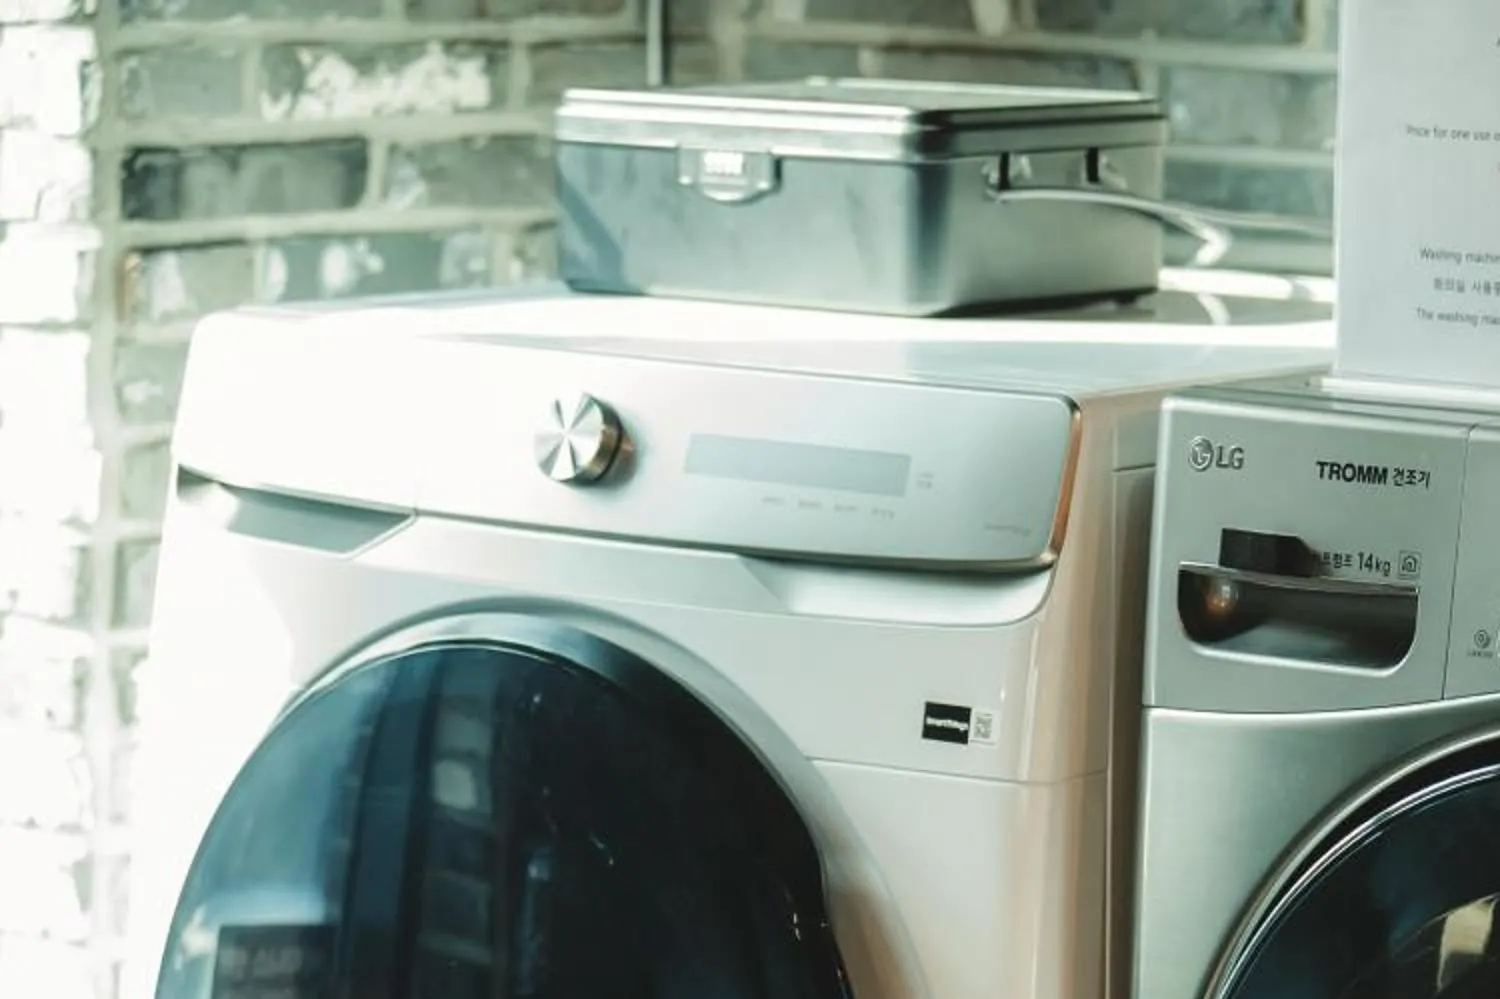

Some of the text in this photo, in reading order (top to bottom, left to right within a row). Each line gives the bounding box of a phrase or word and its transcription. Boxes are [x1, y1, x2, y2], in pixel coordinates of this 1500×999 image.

[1433, 126, 1448, 138] for
[1450, 129, 1471, 140] one
[1473, 131, 1491, 141] use
[1419, 247, 1463, 265] Washing
[1417, 305, 1433, 320] The
[1437, 312, 1479, 329] washing
[1215, 445, 1245, 470] LG
[1315, 460, 1431, 489] TROMM 건조기
[1357, 551, 1391, 577] 14kg
